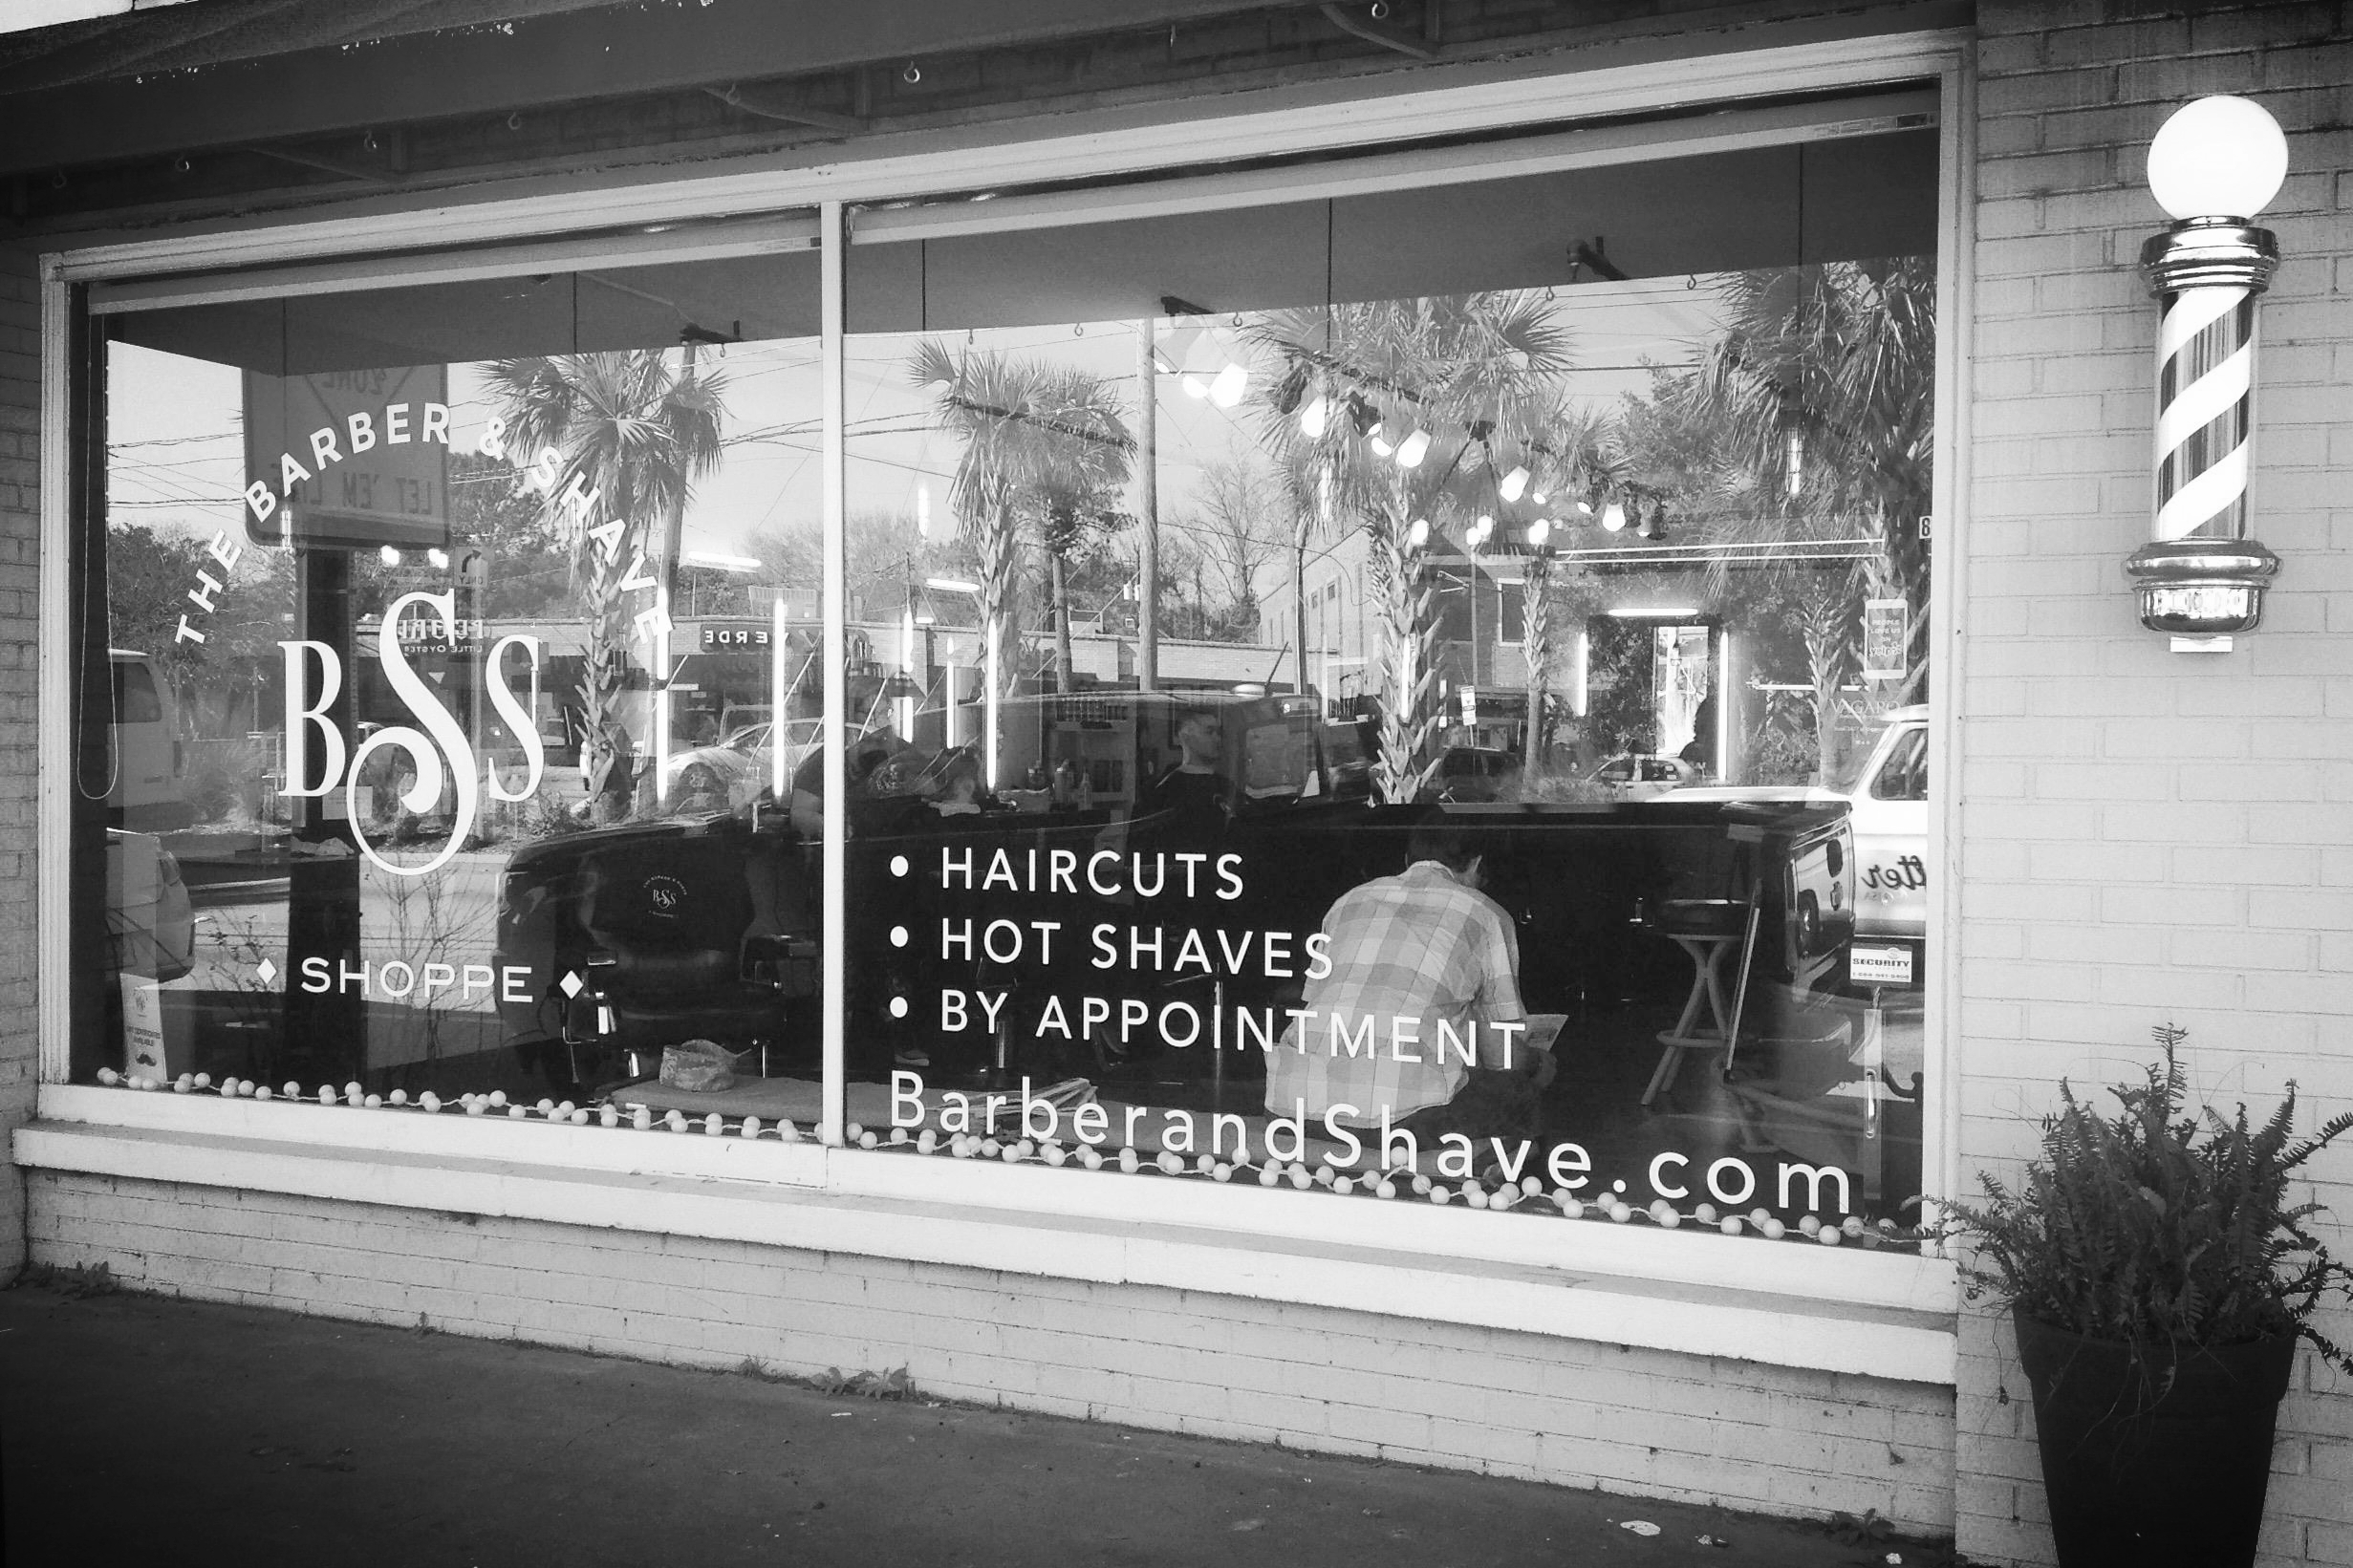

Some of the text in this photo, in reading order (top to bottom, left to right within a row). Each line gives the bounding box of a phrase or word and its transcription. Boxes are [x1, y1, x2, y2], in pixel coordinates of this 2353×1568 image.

[175, 401, 675, 646] THE BARBER & SHAVE
[278, 589, 544, 876] BSS
[942, 848, 1243, 900] HAIRCUTS
[301, 956, 533, 1002] SHOPPE
[942, 917, 1332, 980] HOT SHAVES
[1852, 957, 1910, 967] SECURITY
[941, 989, 1525, 1069] BY APPOINTMENT
[891, 1070, 1850, 1214] BarberandShave.com
